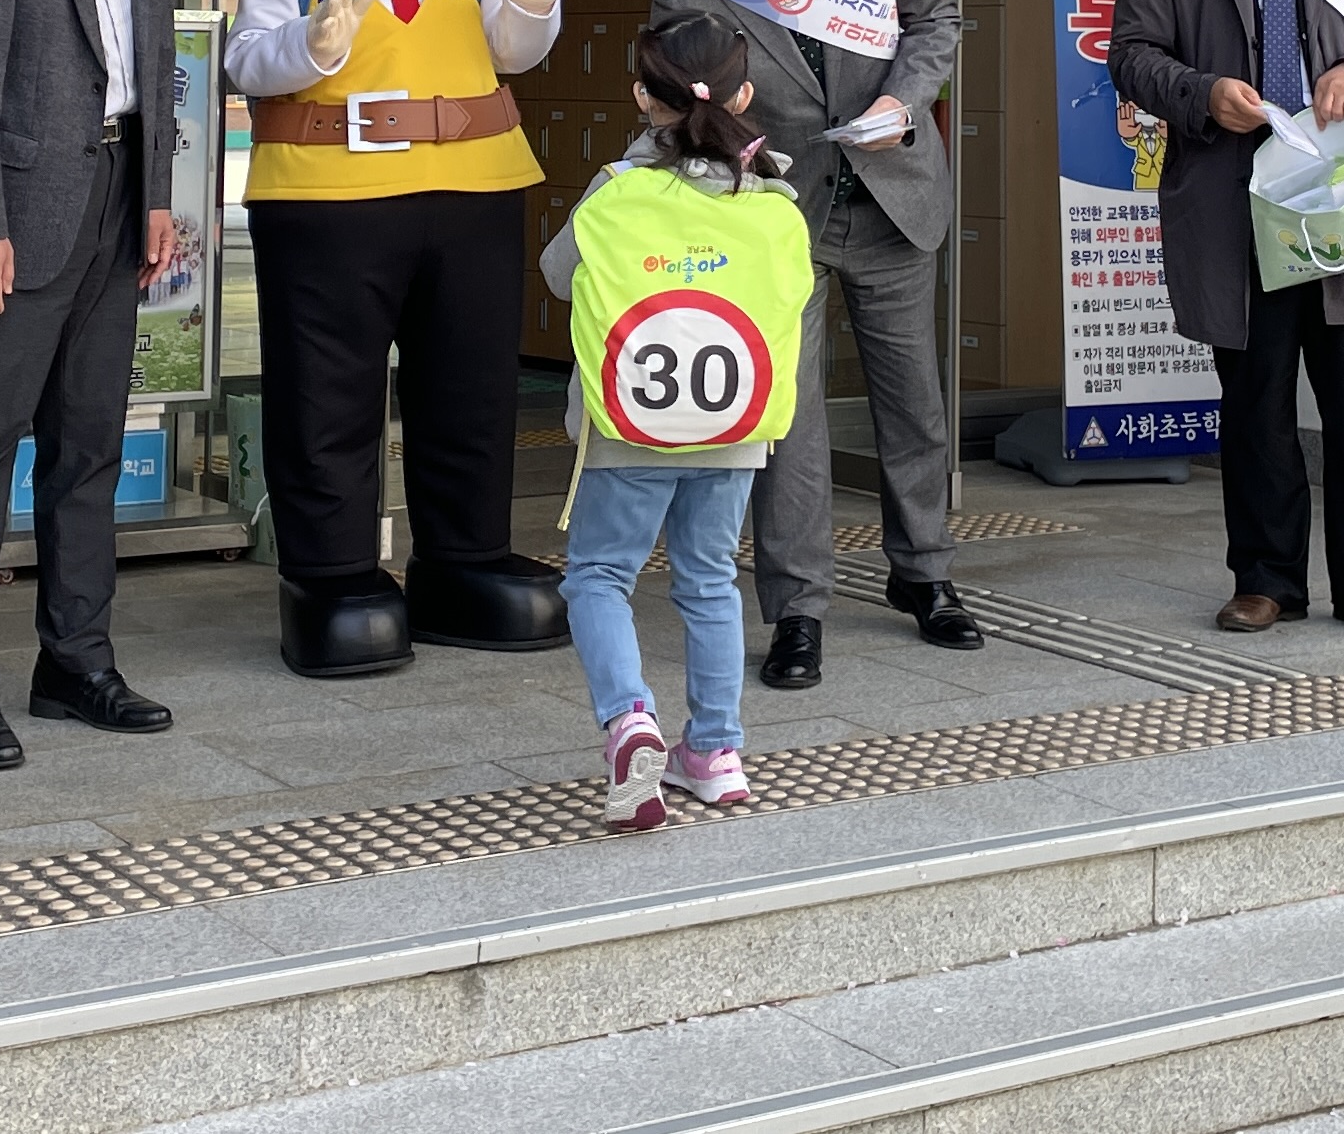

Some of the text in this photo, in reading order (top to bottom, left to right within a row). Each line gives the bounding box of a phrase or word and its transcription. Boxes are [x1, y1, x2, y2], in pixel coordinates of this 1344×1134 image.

[1069, 204, 1160, 222] 안전한 교육활동과
[1070, 227, 1091, 243] 위해
[1096, 227, 1129, 243] 외부인
[1070, 250, 1103, 266] 용무가
[1108, 249, 1141, 265] 있으신
[643, 254, 728, 284] 아이좋아
[1071, 271, 1093, 288] 확인
[1097, 270, 1108, 287] 후
[1082, 298, 1110, 313] 출입시
[1114, 297, 1142, 312] 반드시
[1082, 323, 1101, 337] 발열
[1117, 322, 1136, 336] 증상
[1140, 321, 1168, 334] 체크후
[1083, 347, 1102, 361] 자가
[1106, 346, 1123, 359] 격리
[1127, 343, 1184, 358] 대상자이거나
[1188, 343, 1205, 356] 최근
[1084, 363, 1102, 376] 이내
[1106, 362, 1124, 376] 해외
[1128, 361, 1155, 376] 방문자
[631, 343, 739, 412] 30
[1085, 379, 1122, 394] 출입금지
